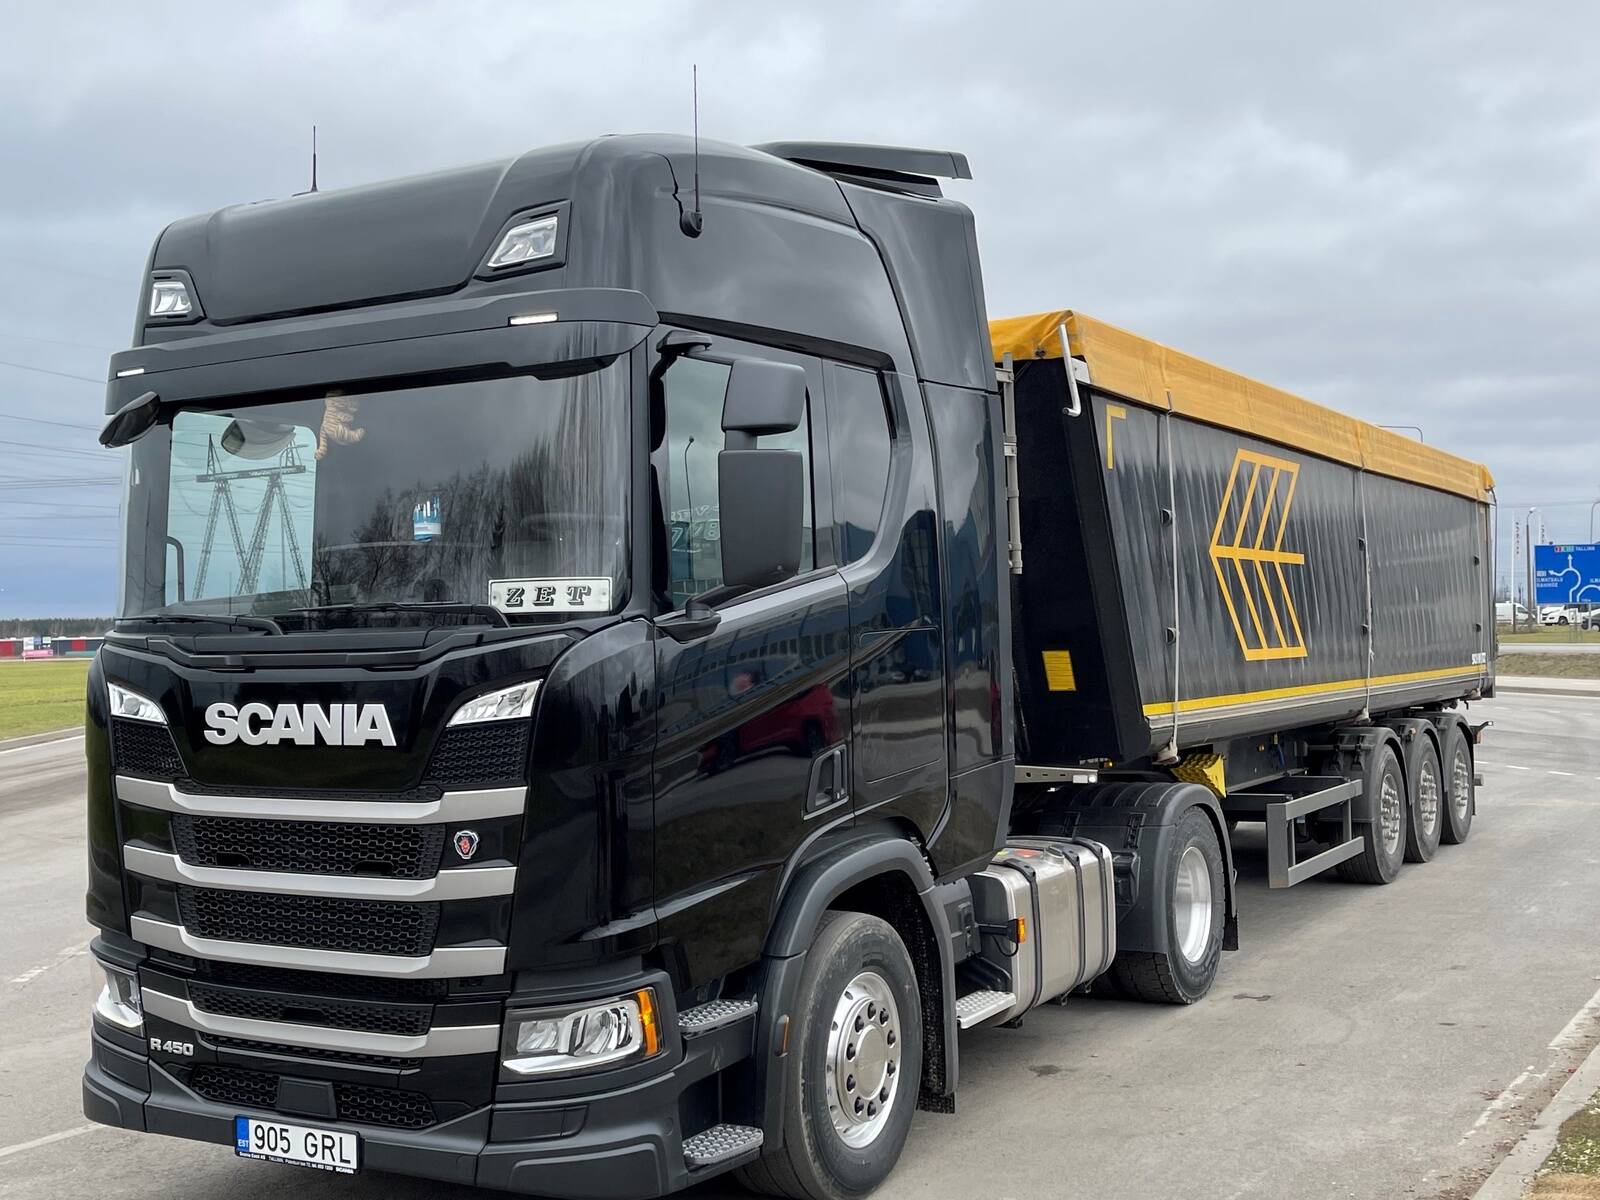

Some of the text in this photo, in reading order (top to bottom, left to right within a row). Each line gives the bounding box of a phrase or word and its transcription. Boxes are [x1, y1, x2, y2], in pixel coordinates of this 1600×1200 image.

[505, 585, 591, 607] ZET
[203, 702, 397, 747] SCANIA
[238, 1124, 351, 1165] EST 905 GRL
